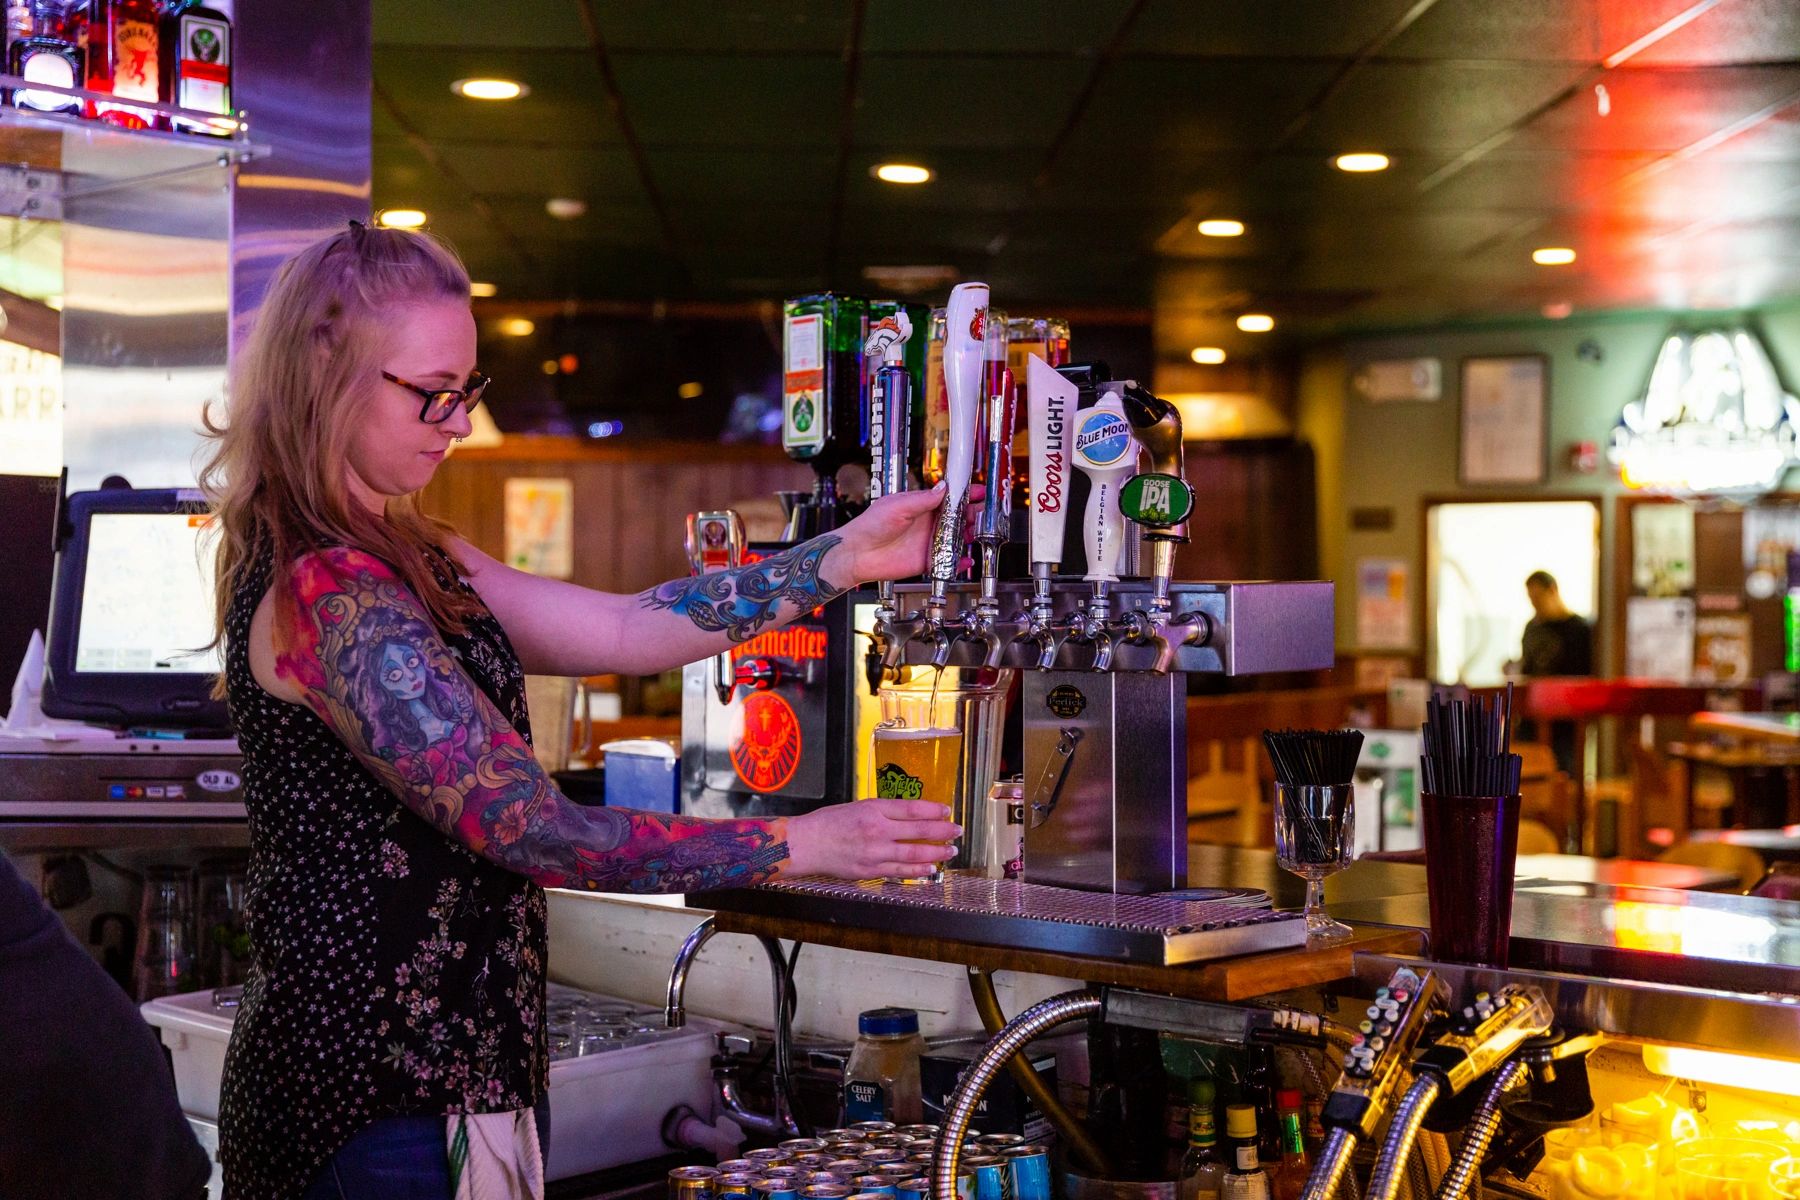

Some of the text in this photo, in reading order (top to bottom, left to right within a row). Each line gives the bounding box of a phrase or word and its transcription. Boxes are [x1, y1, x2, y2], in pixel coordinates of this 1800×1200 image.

[871, 384, 883, 473] LIGHT
[1038, 451, 1063, 513] Coors
[1143, 479, 1171, 488] GOOSE
[1097, 484, 1107, 527] BELGIAN
[1139, 485, 1170, 514] IPA
[202, 774, 219, 785] OLD
[851, 1084, 877, 1095] CELERY
[855, 1094, 872, 1103] SALT
